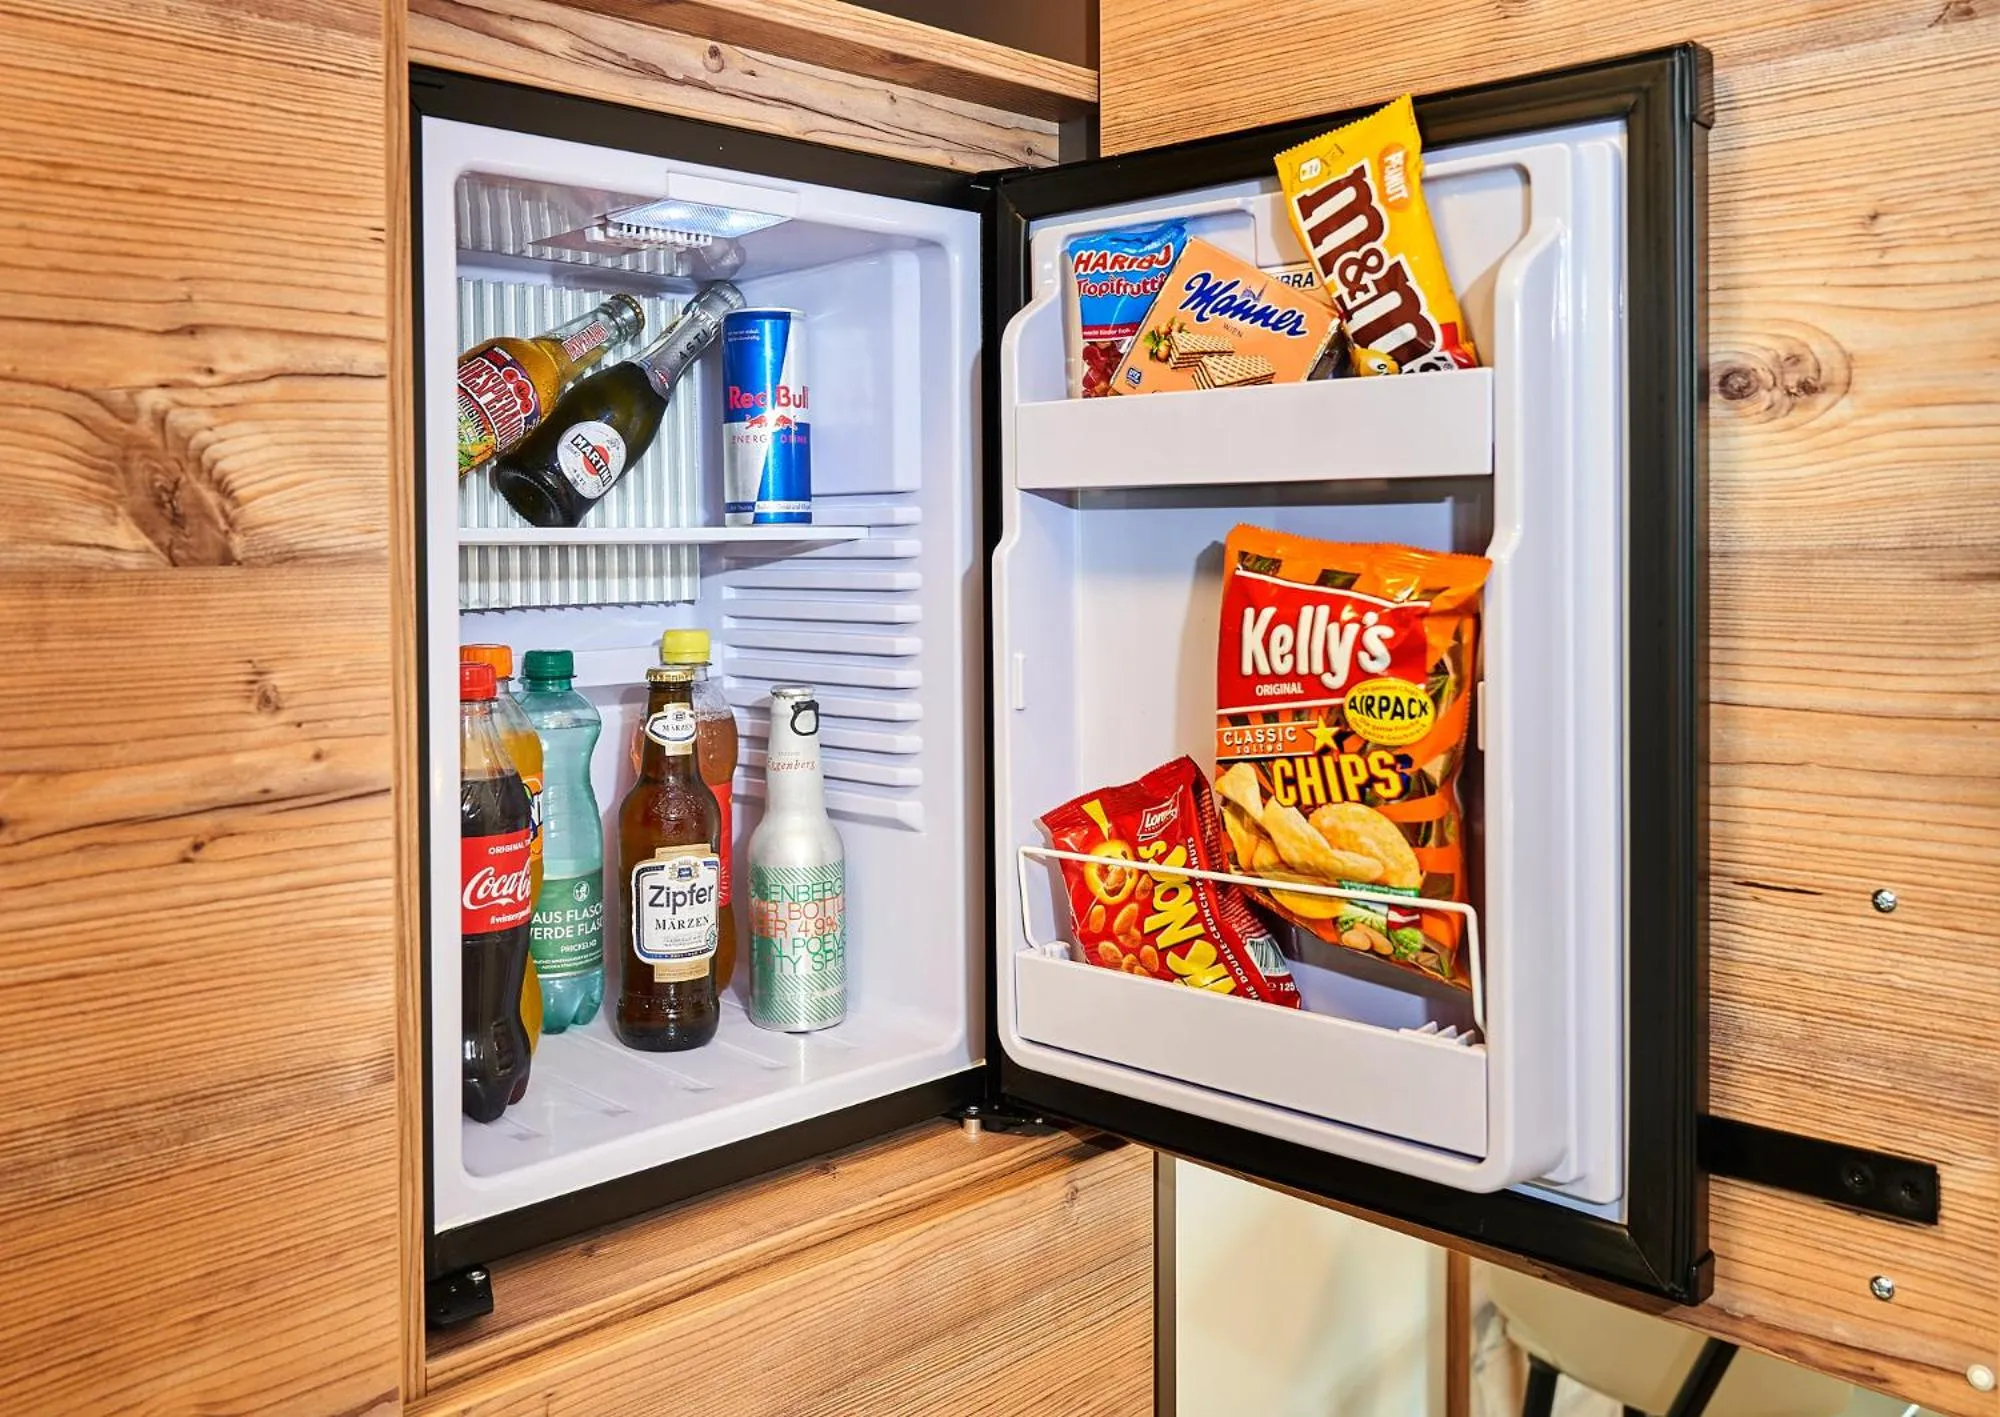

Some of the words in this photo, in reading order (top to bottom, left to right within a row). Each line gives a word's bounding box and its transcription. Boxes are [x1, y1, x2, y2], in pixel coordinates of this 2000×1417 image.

[1277, 271, 1315, 288] BRA
[1178, 271, 1308, 338] Manner
[1223, 321, 1244, 338] WIEN
[775, 385, 809, 410] Bull
[732, 433, 770, 444] ENERG
[571, 434, 613, 487] MARTINI
[1240, 604, 1396, 690] Kelly's
[1255, 681, 1305, 697] ORIGINAL
[1348, 695, 1429, 720] AIRPACK
[1223, 726, 1297, 747] CLASSIC
[1272, 750, 1404, 808] CHIPS
[648, 882, 714, 915] Zipfer
[531, 911, 562, 925] AUS
[566, 902, 603, 923] FLASC
[655, 914, 710, 931] MÄRZEN
